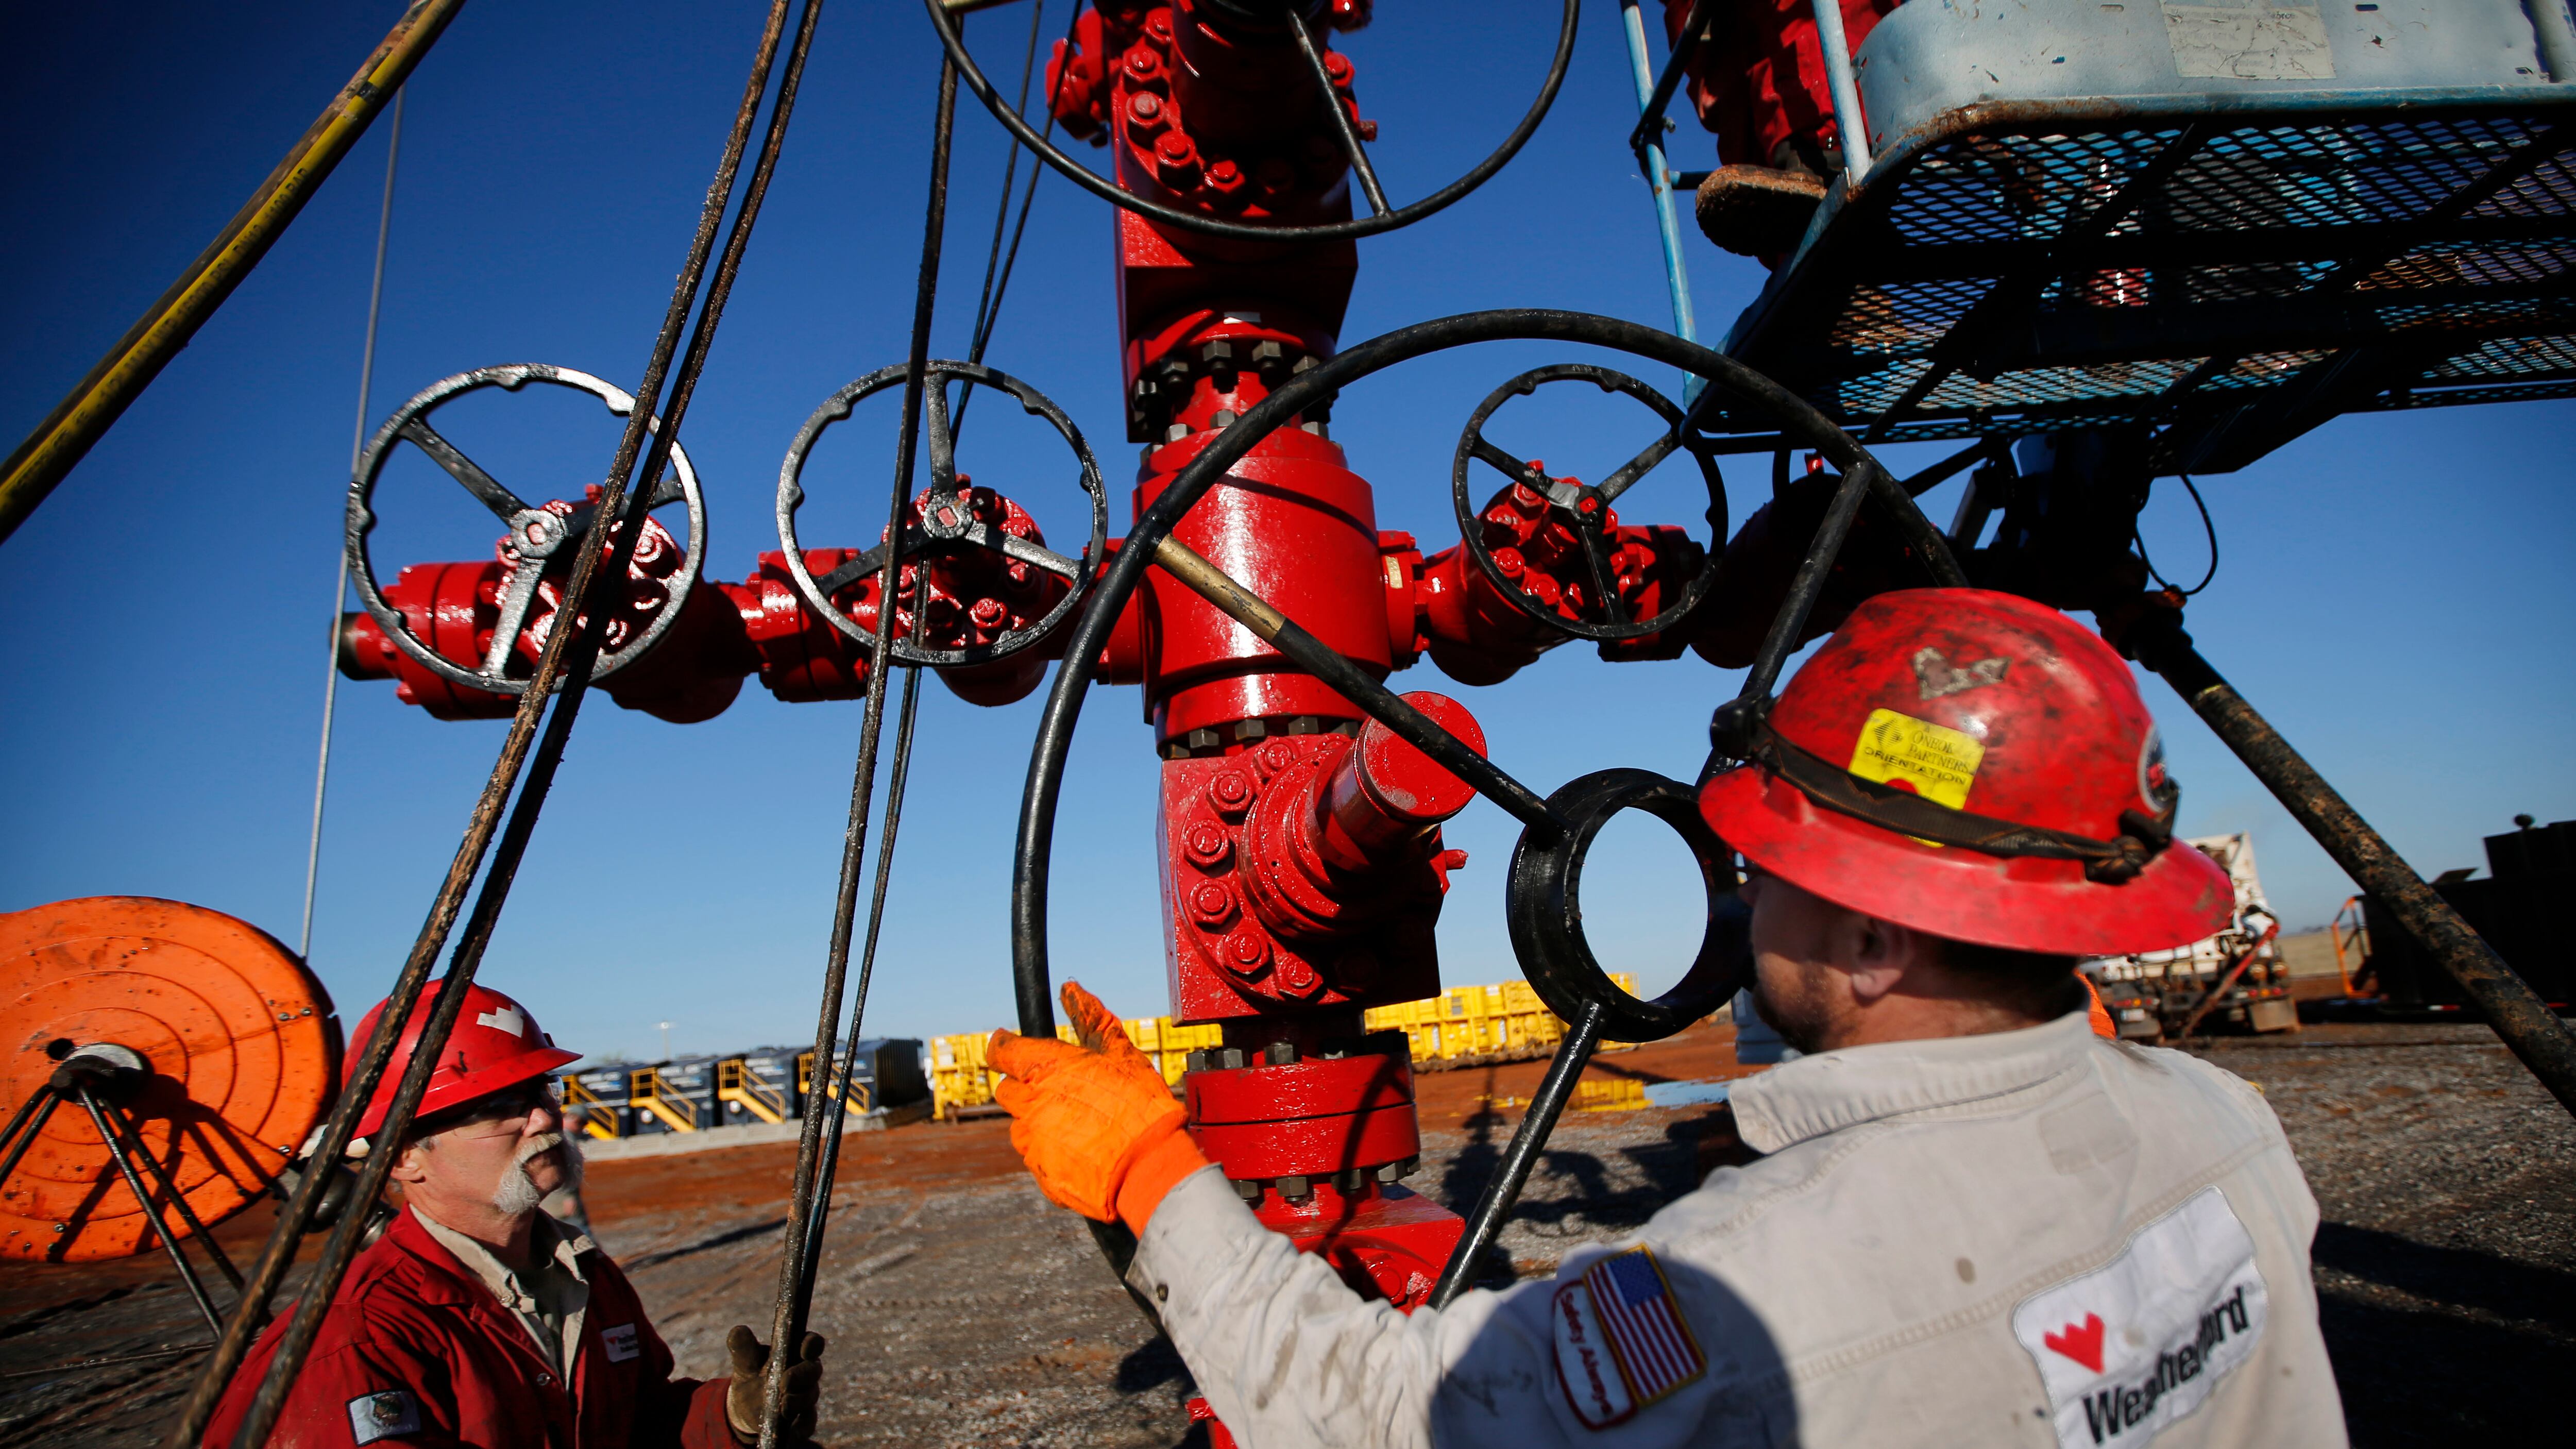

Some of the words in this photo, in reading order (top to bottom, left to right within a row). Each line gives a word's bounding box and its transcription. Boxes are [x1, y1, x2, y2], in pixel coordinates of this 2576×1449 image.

[1908, 744, 1970, 772] PARTNERS
[1912, 730, 1954, 753] ONEOK
[1864, 747, 1965, 784] ORIENTATION
[1561, 1292, 1585, 1343] Safety
[2083, 1286, 2249, 1444] Weaherord
